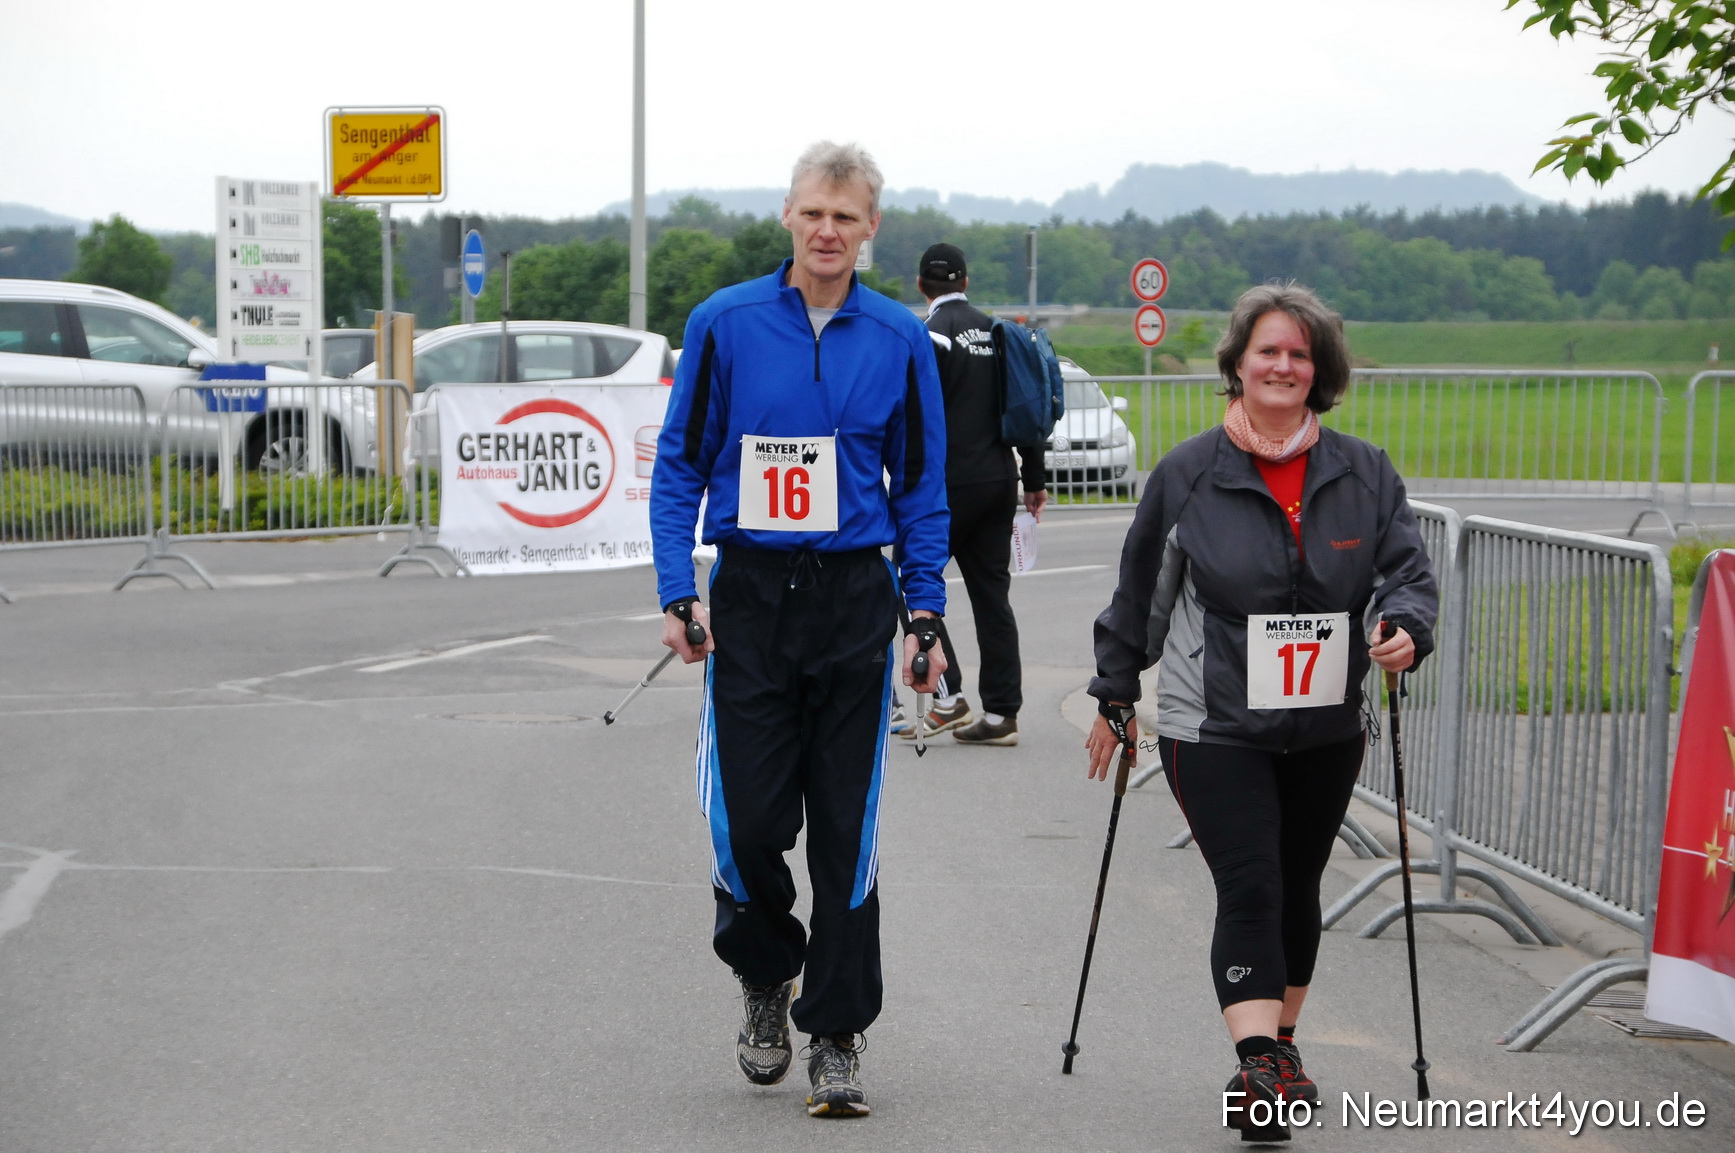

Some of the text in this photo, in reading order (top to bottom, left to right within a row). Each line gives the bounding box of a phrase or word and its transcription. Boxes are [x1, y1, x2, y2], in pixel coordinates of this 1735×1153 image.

[340, 123, 431, 149] Sengenthal
[352, 150, 418, 165] am Anger
[362, 174, 402, 184] Neumarkt
[240, 243, 260, 266] SHB
[1140, 271, 1160, 289] 60
[241, 304, 273, 326] THULE
[969, 344, 994, 355] FC Holz
[458, 431, 596, 462] GERHART &
[755, 441, 798, 454] MEYER
[755, 453, 799, 463] WERBUNG
[456, 461, 601, 492] Autohaus JÄNIG
[625, 488, 651, 501] SE
[763, 466, 810, 521] 16
[454, 547, 510, 566] Neumarkt
[520, 542, 589, 566] Sengenthal
[601, 541, 621, 560] Tel.
[624, 538, 655, 559] 0918
[1011, 522, 1024, 572] URKUNDE
[1265, 619, 1313, 631] MEYER
[1265, 631, 1314, 640] WERBUNG
[1277, 642, 1321, 696] 17
[1116, 722, 1126, 739] LEKI
